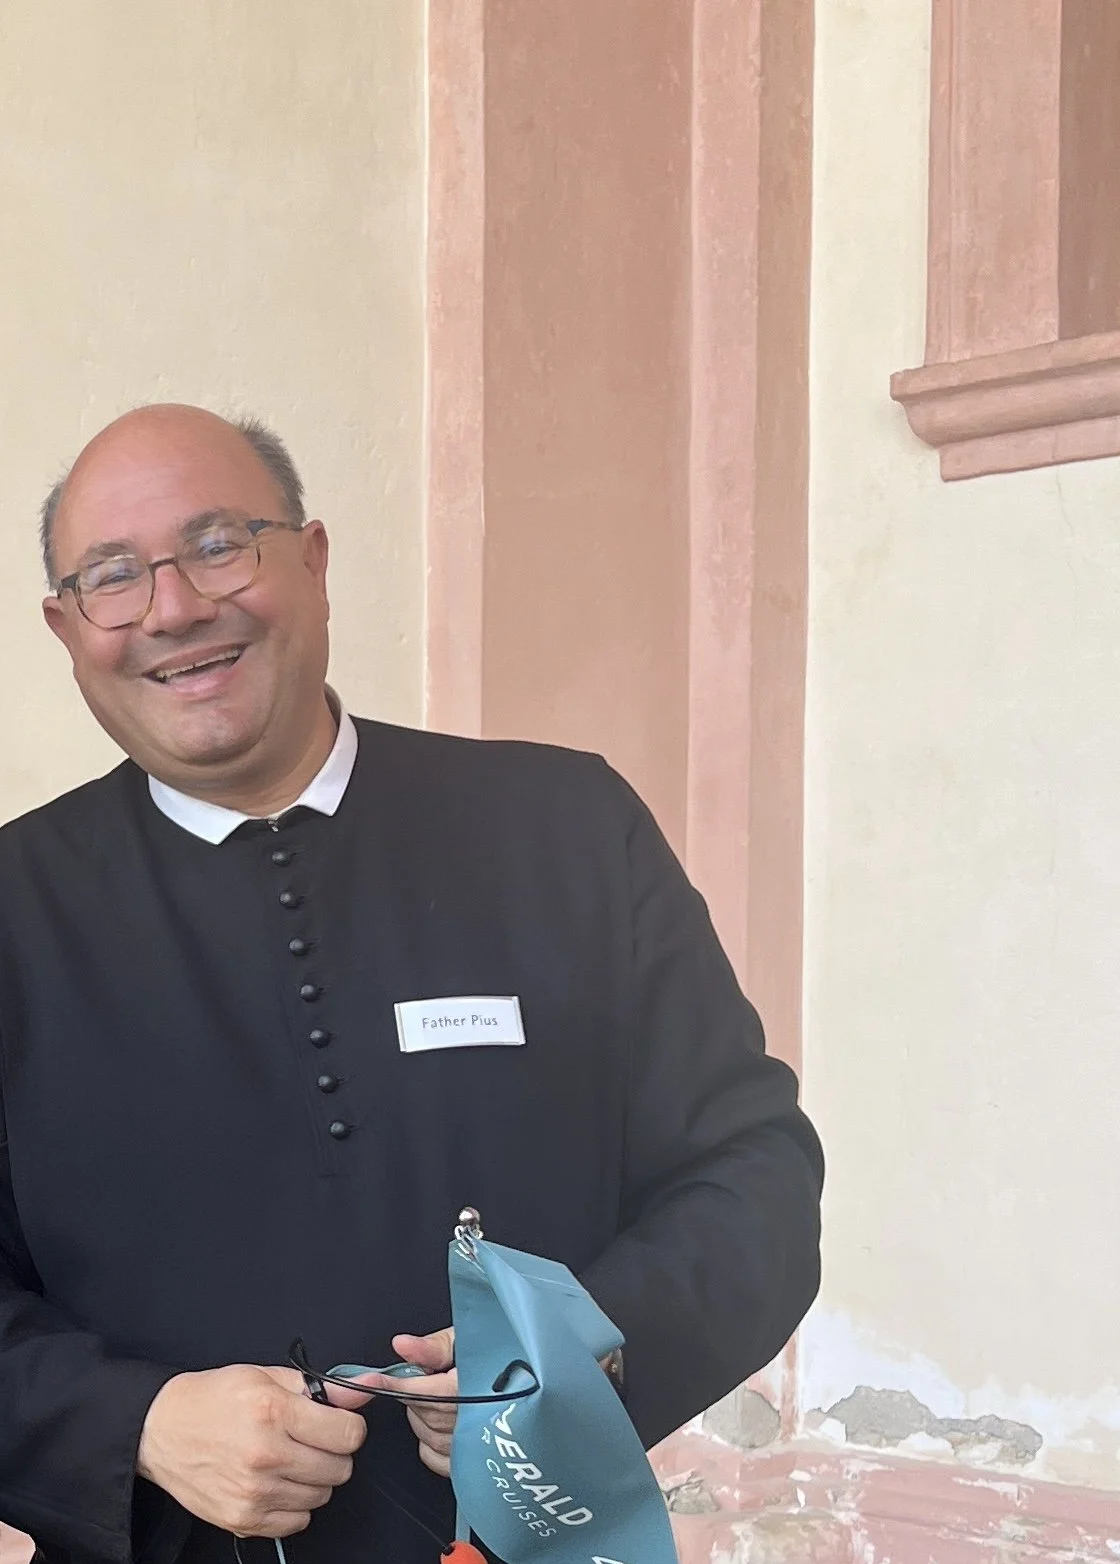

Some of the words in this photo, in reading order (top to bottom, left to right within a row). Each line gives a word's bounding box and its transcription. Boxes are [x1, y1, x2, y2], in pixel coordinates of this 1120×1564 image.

[422, 1016, 466, 1029] Father
[471, 1014, 498, 1026] Pius
[486, 1458, 557, 1537] CRUISES
